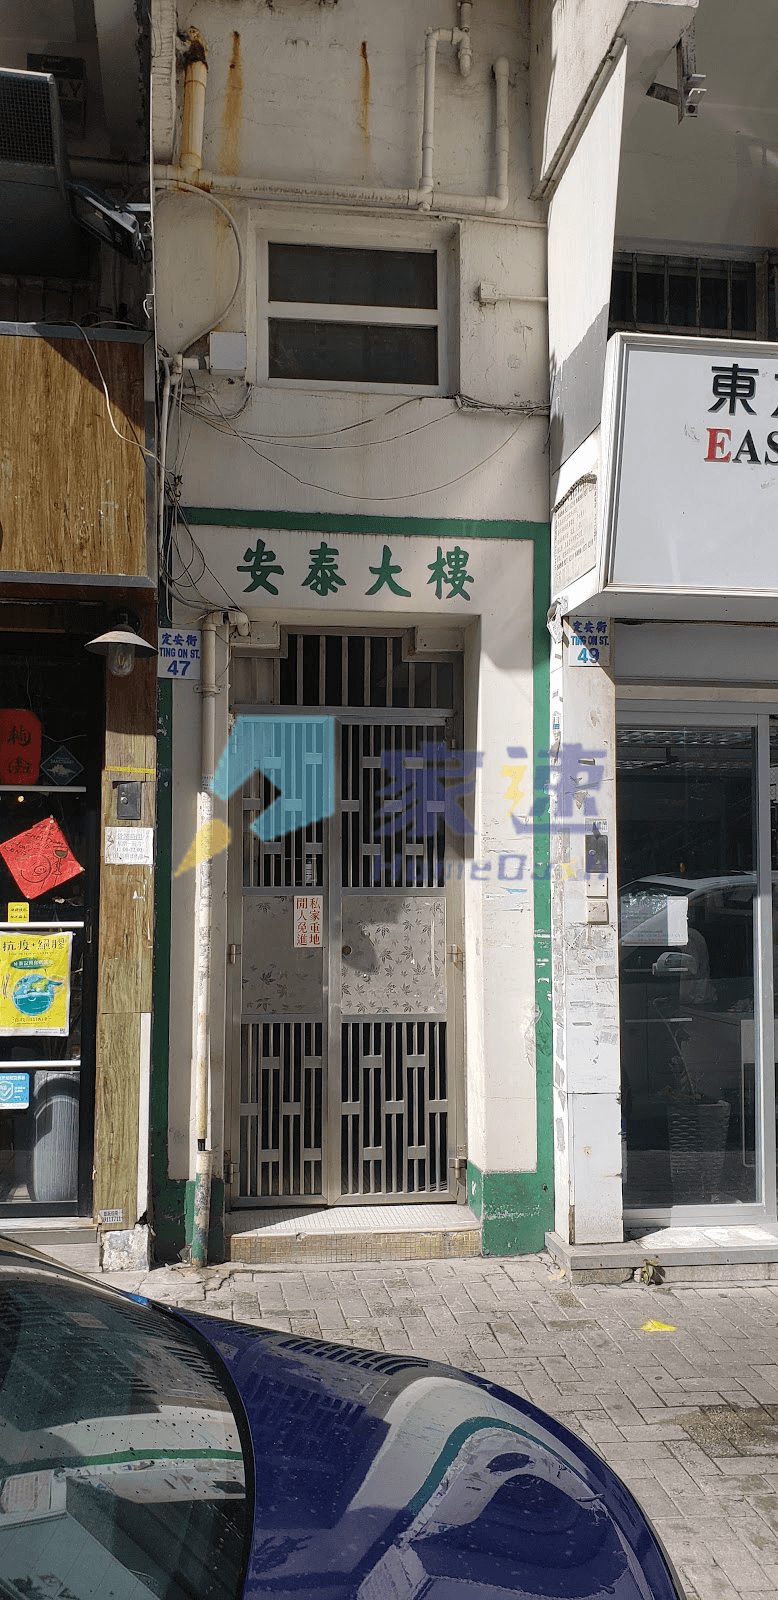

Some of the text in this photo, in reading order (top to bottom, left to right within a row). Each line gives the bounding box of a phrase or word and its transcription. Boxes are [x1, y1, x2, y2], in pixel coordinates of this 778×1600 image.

[237, 539, 474, 601] 安泰大樓
[573, 620, 607, 633] 定安街
[162, 632, 197, 646] 定安街
[571, 635, 609, 645] TING ON ST.
[160, 647, 200, 659] TING ON ST.
[578, 647, 599, 663] 49
[167, 660, 190, 676] 47
[310, 897, 321, 945] 私家重地
